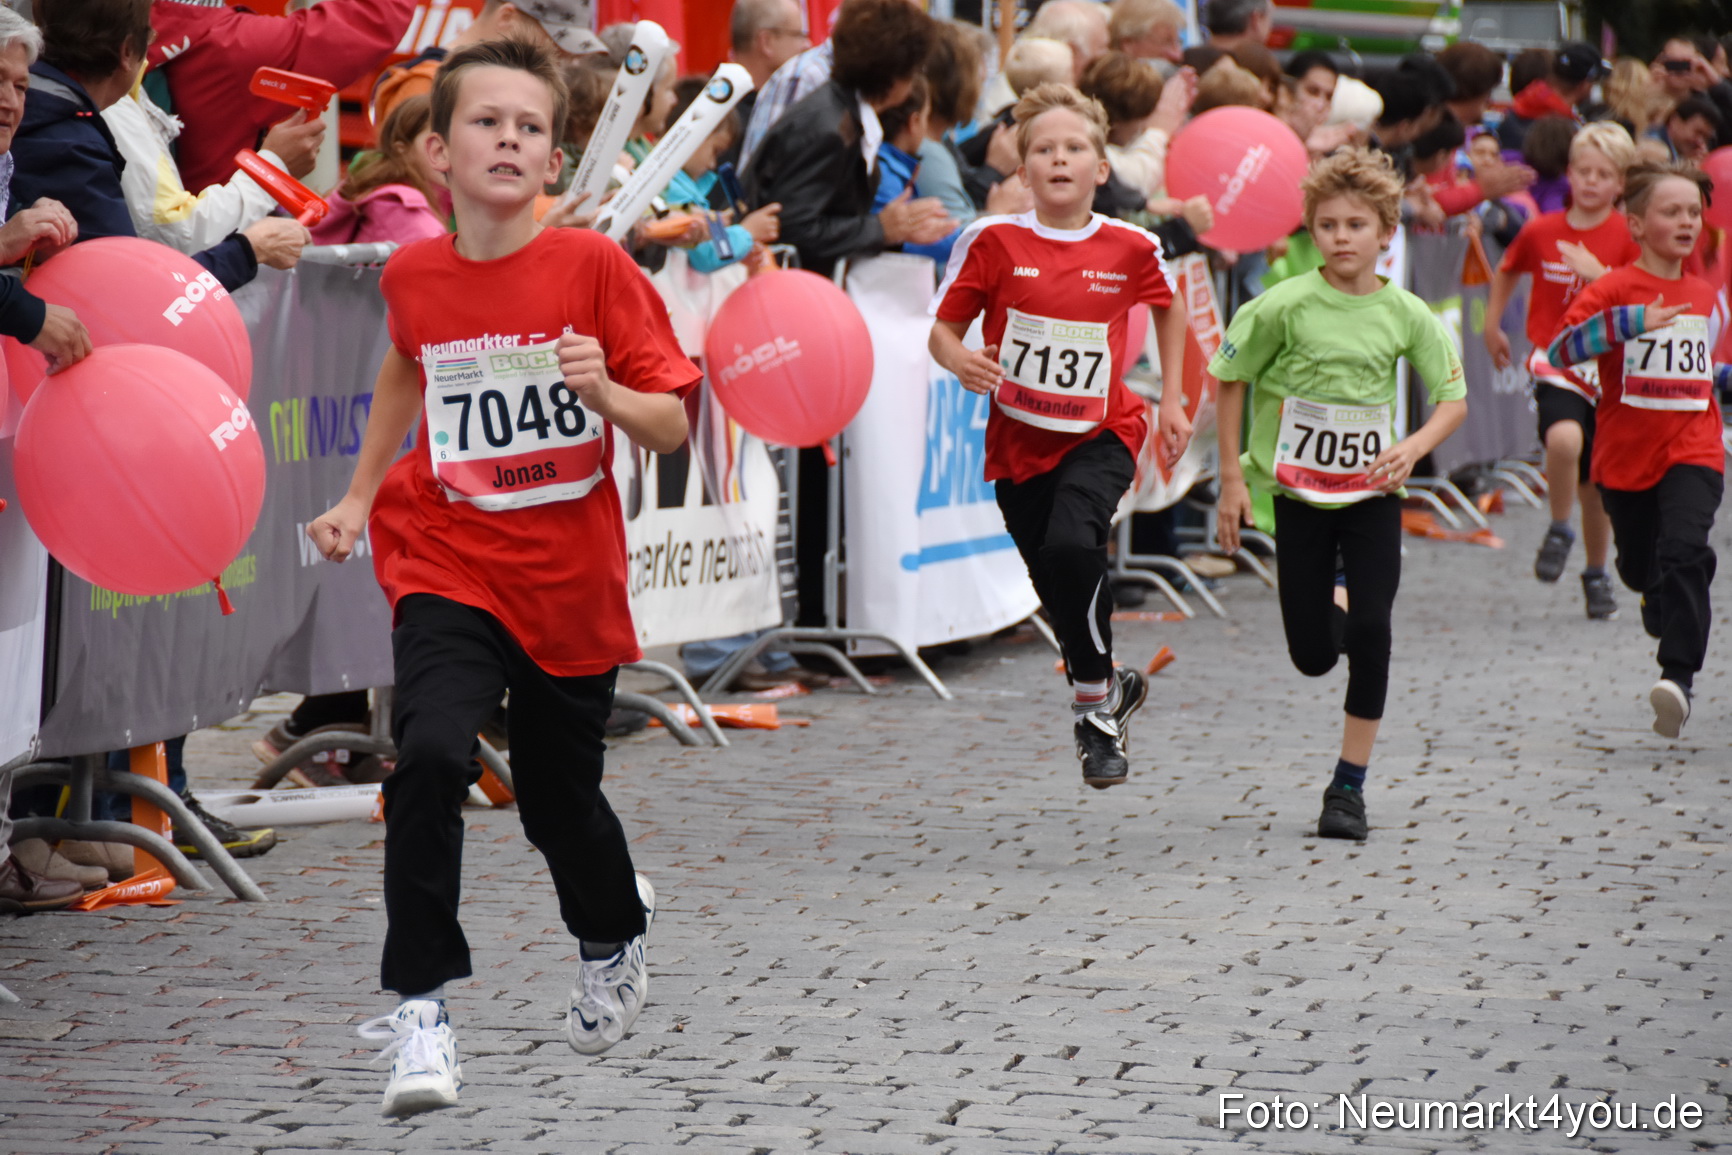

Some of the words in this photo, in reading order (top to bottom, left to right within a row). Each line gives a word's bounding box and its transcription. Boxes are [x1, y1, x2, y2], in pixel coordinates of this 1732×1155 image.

[1013, 266, 1040, 278] JAKO
[1082, 270, 1094, 279] FC
[1086, 282, 1121, 294] Alexander
[1051, 323, 1105, 342] BOCK
[1012, 338, 1103, 390] 7137
[1638, 338, 1706, 374] 7138
[434, 370, 484, 383] NeuerMarkt
[1014, 390, 1087, 417] Alexander
[442, 380, 586, 452] 7048
[440, 450, 447, 460] 6
[1294, 423, 1381, 469] 7059
[493, 461, 558, 488] Jonas
